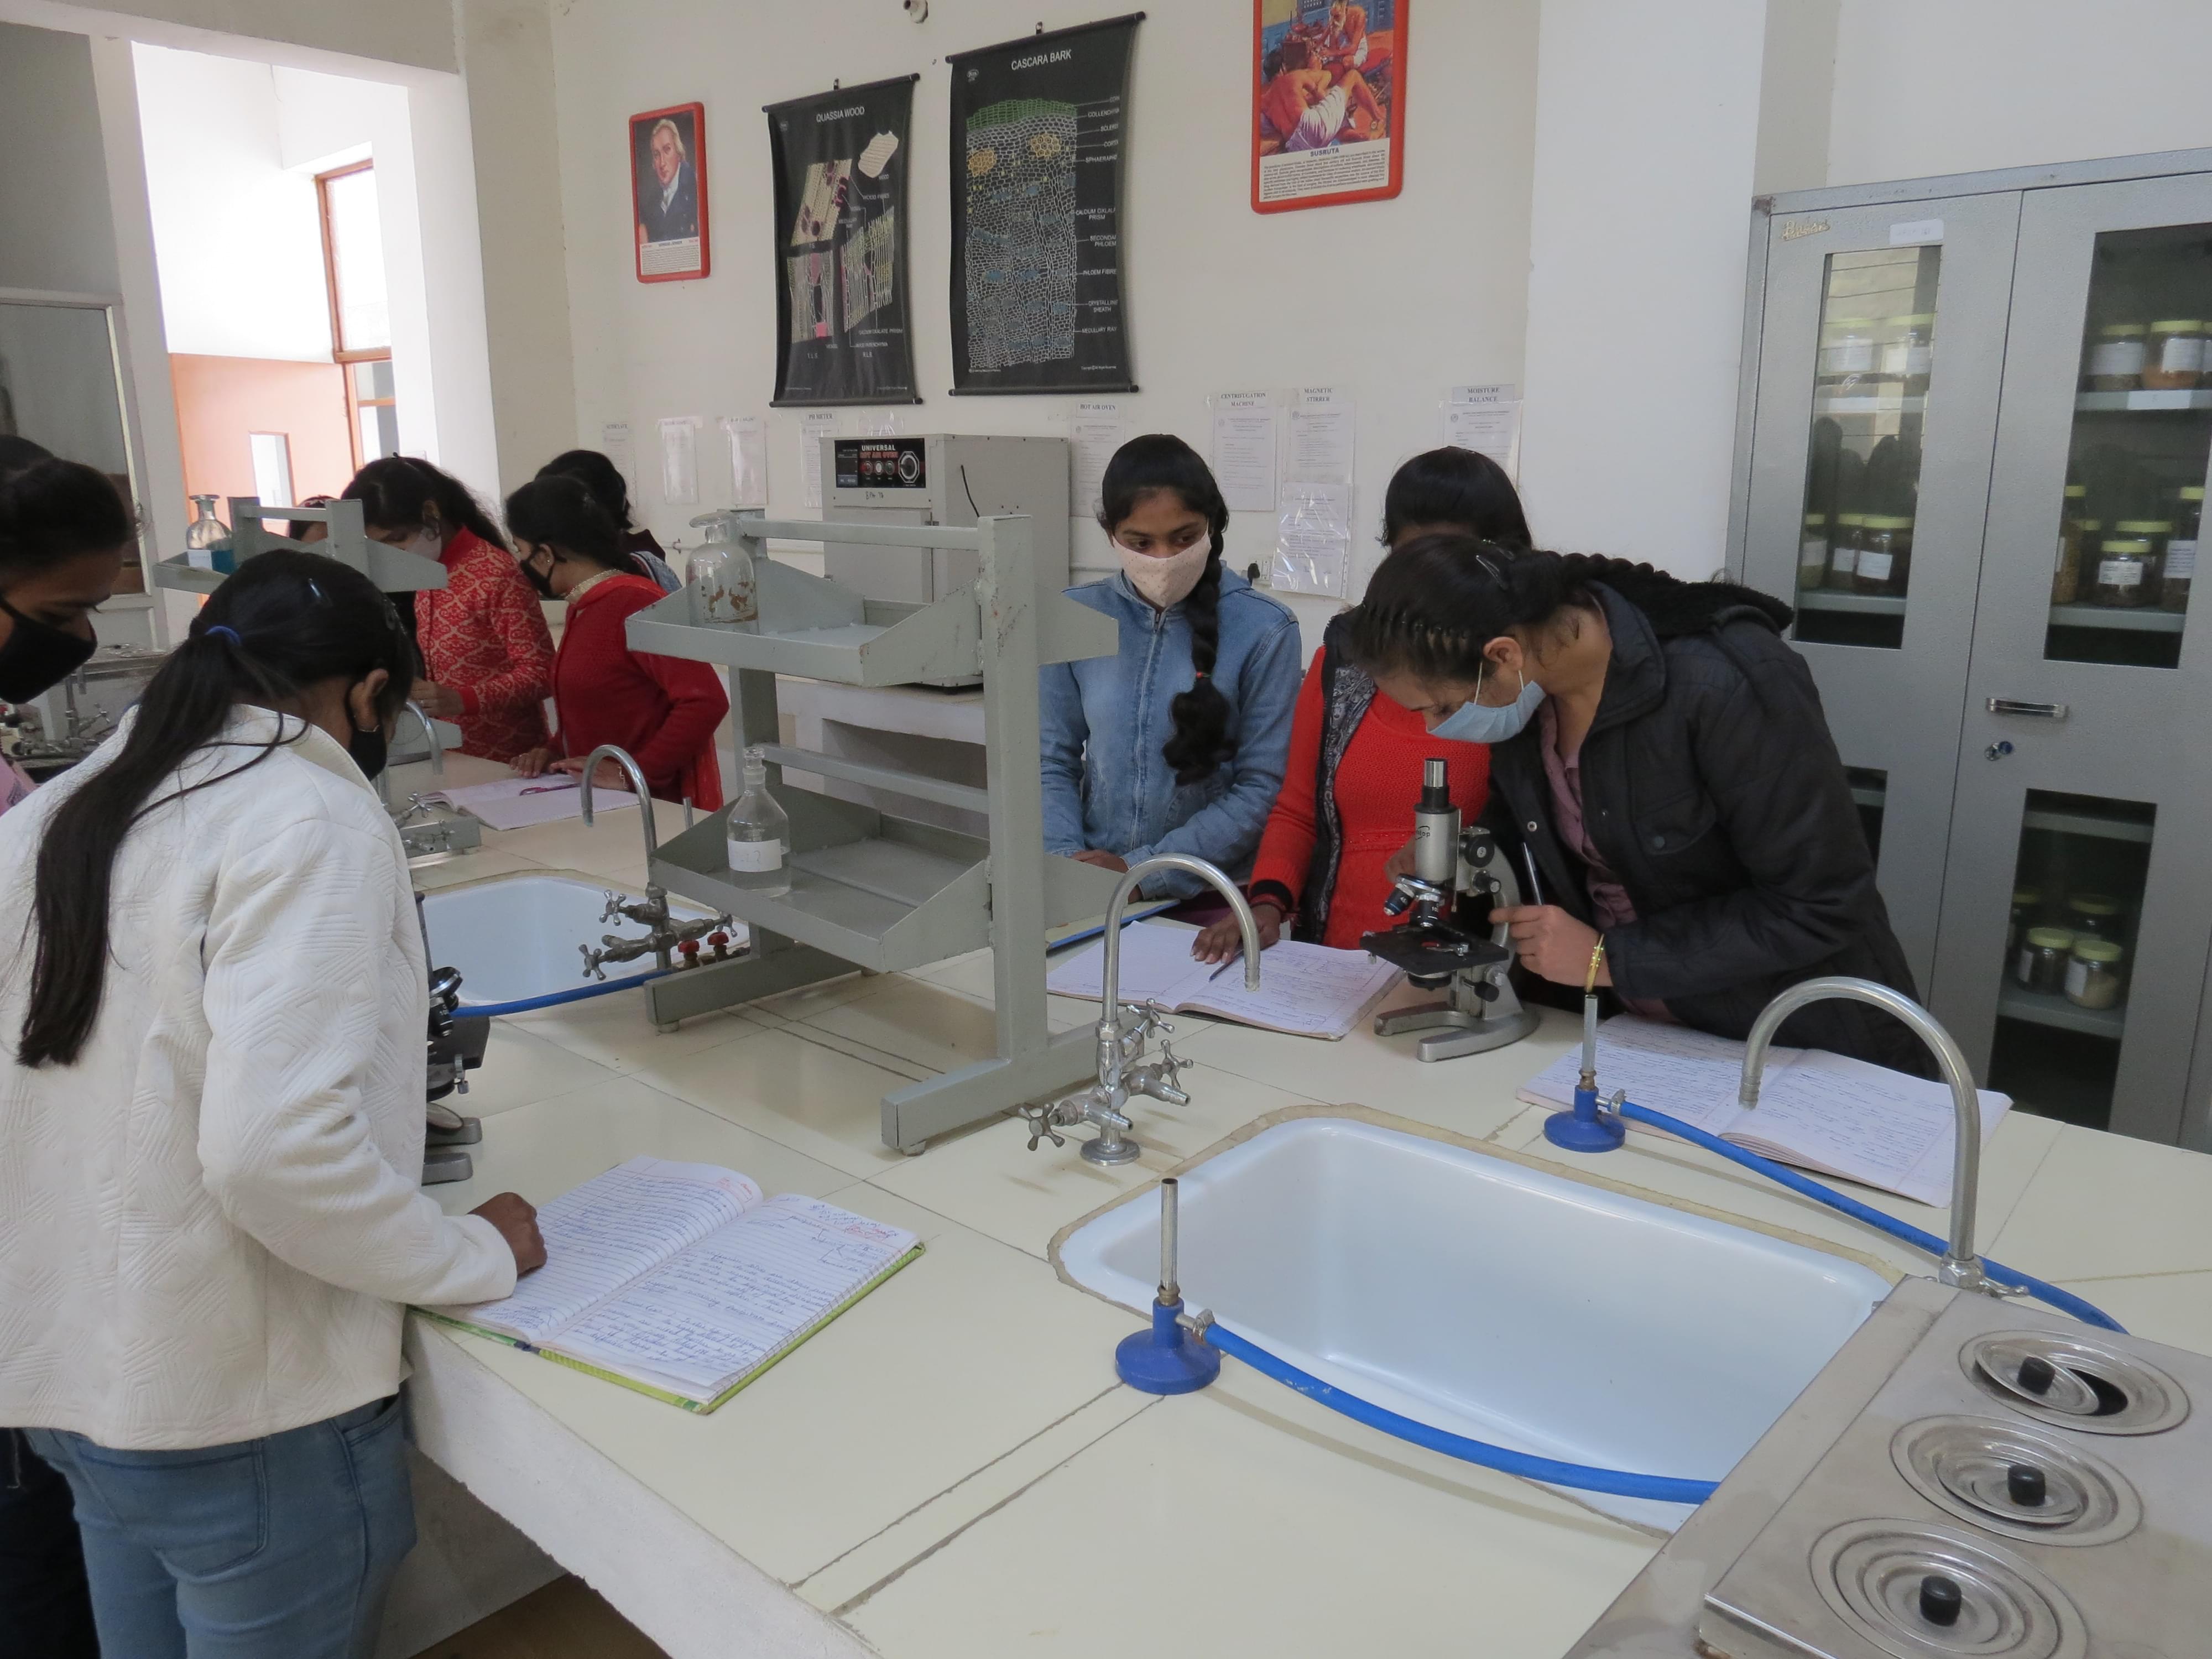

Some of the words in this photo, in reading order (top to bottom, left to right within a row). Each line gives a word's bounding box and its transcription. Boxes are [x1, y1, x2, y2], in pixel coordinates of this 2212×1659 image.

[1011, 54, 1048, 71] CASCARA
[1050, 49, 1072, 62] BARK
[816, 110, 844, 123] QUASSIA
[845, 106, 865, 117] WOOD
[1310, 147, 1339, 157] SUSRUTA
